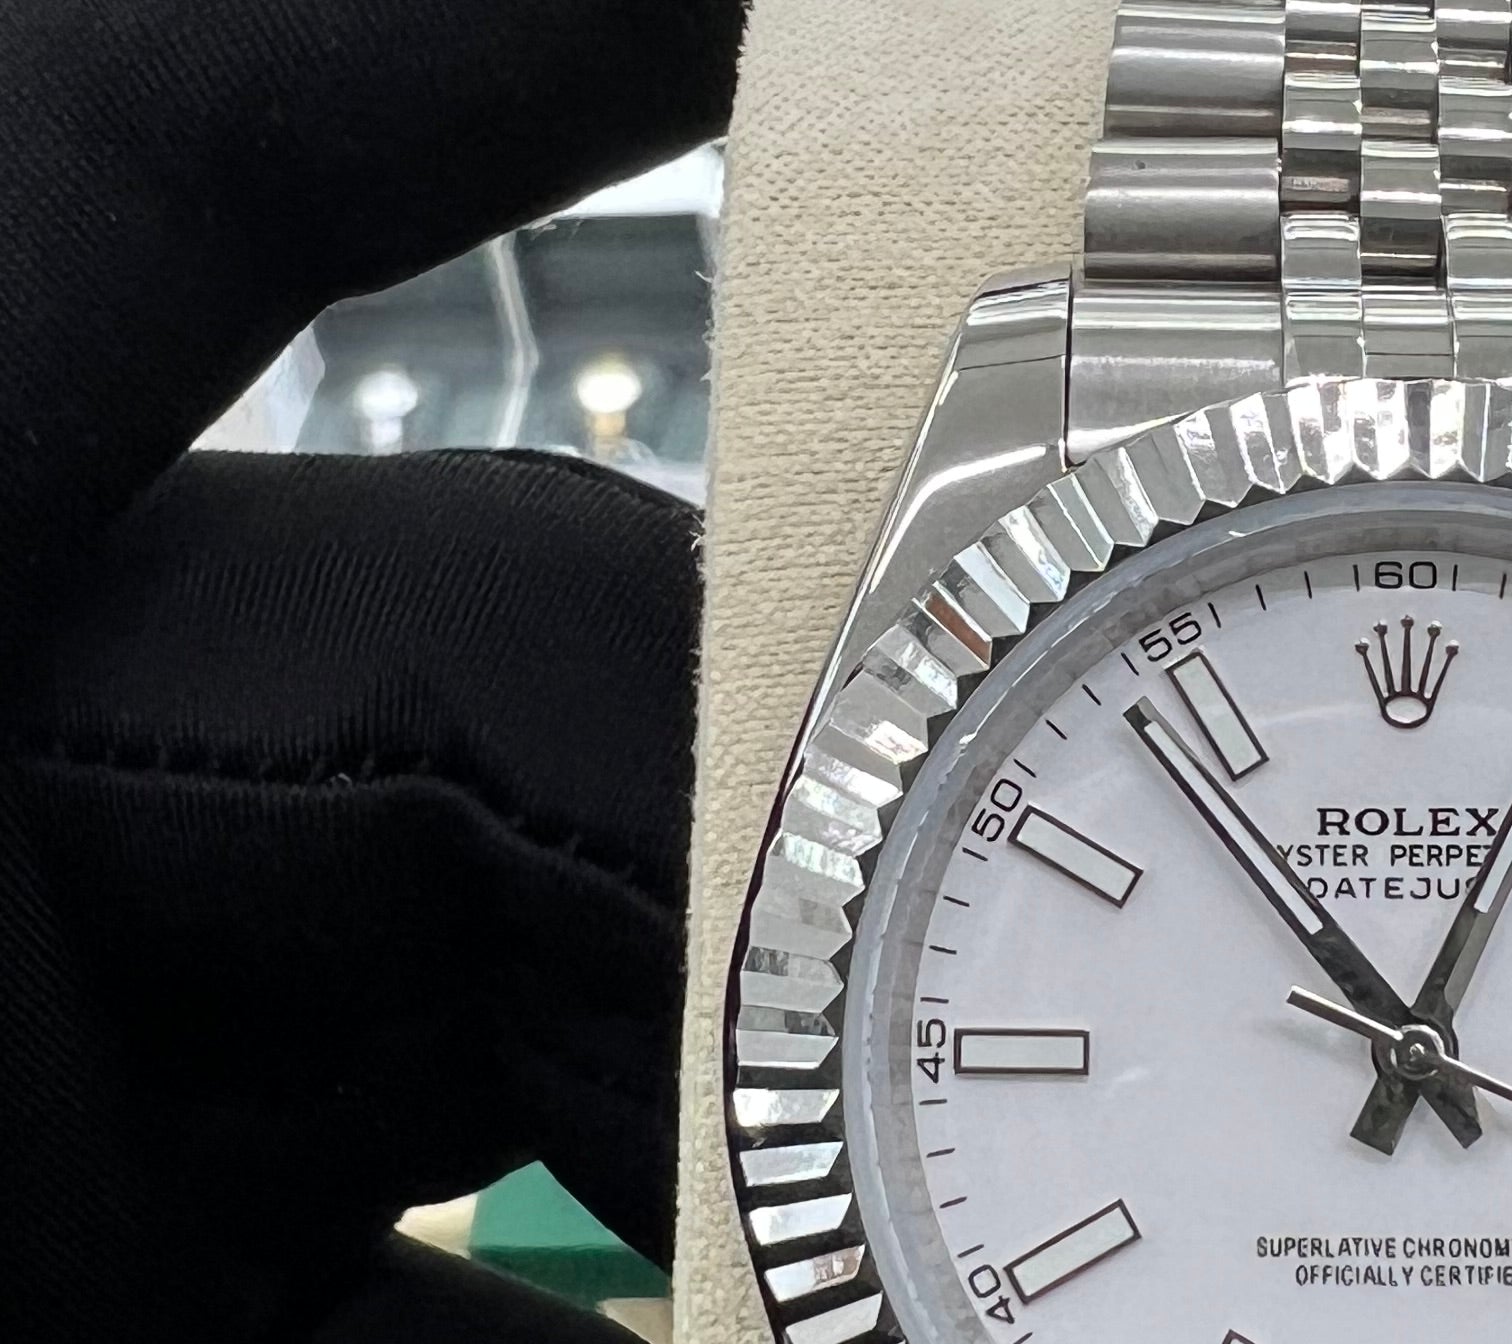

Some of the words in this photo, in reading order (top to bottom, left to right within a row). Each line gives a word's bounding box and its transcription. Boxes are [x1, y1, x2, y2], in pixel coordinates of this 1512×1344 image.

[1373, 560, 1438, 591] 60
[1138, 611, 1203, 664] 55
[971, 778, 1024, 843] 50
[1316, 807, 1500, 837] ROLEX
[1276, 843, 1370, 868] YSTER
[1306, 876, 1478, 900] DATEJU
[916, 1017, 948, 1084] 45
[1256, 1236, 1397, 1259] SUPERLATIVE
[1295, 1264, 1414, 1287] OFFICIALLY
[967, 1263, 1016, 1325] 40
